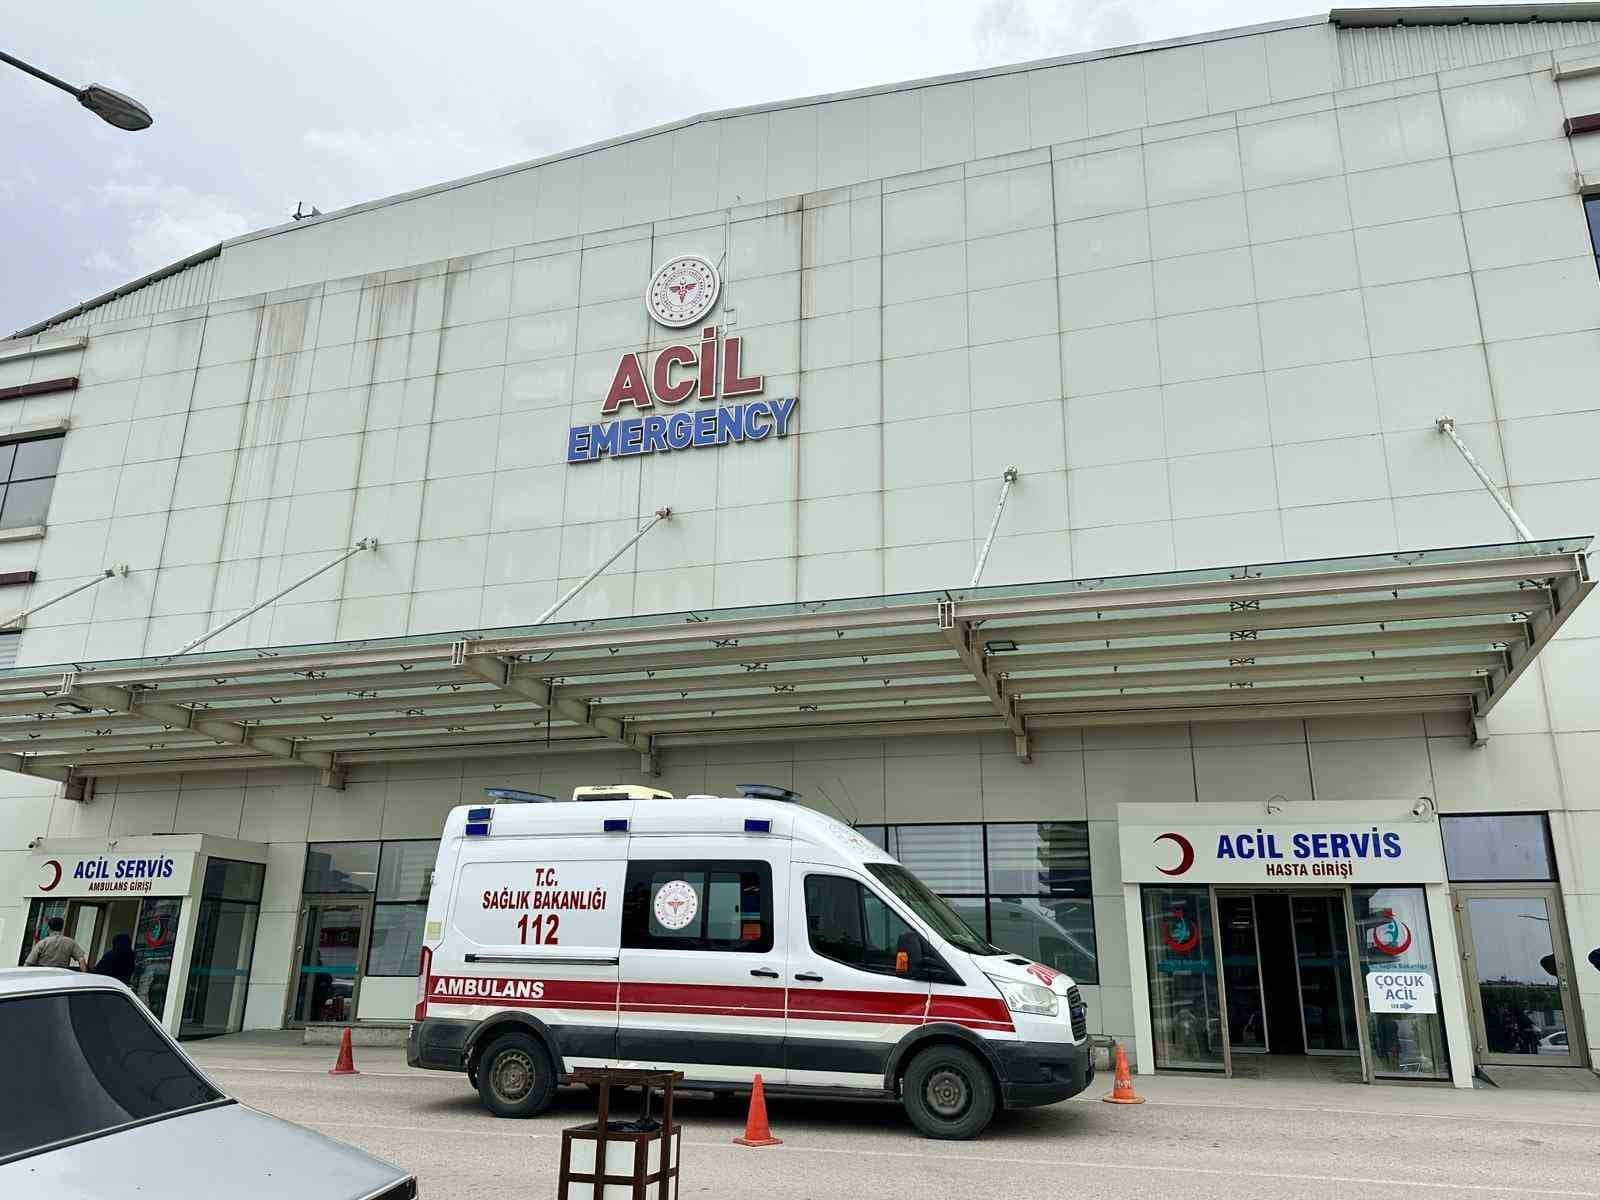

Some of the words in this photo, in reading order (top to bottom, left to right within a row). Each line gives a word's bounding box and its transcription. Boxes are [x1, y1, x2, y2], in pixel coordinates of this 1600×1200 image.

[601, 326, 764, 415] ACİL
[567, 397, 798, 463] EMERGENCY
[1216, 828, 1284, 859] ACİL
[1292, 826, 1402, 859] SERVİS
[73, 856, 110, 879] ACİL
[115, 855, 174, 878] SERVİS
[535, 867, 558, 887] T.C.
[1266, 863, 1308, 876] HASTA
[1312, 860, 1353, 879] GİRİŞİ
[88, 882, 128, 892] AMBULANS
[129, 879, 153, 894] GİRİŞİ
[482, 886, 529, 910] SAĞLIK
[533, 887, 607, 910] BAKANLIĞI
[517, 913, 560, 945] 112
[434, 978, 545, 999] AMBULANS
[1375, 975, 1424, 989] ÇOCUK
[1385, 986, 1417, 1000] ACİL
